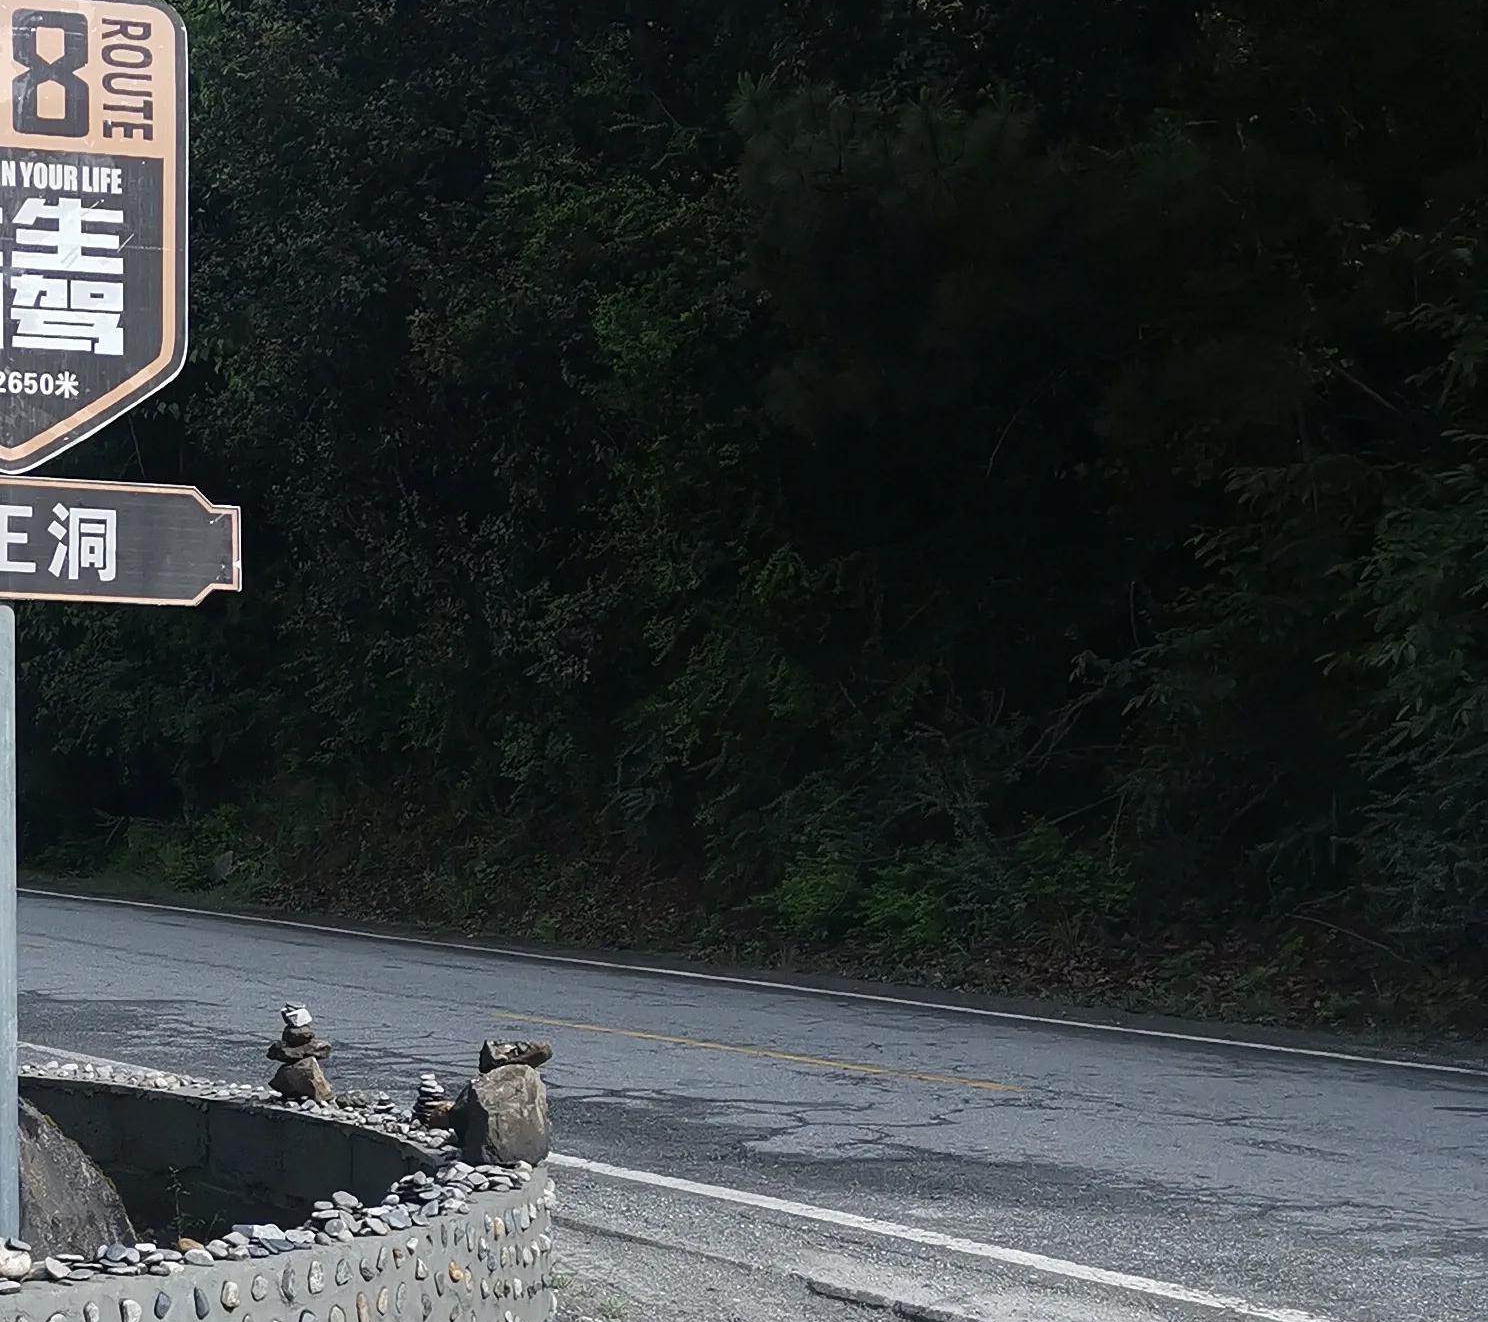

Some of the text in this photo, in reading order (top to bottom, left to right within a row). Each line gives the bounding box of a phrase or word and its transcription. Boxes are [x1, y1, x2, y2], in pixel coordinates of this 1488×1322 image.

[100, 15, 154, 143] ROUTE
[20, 161, 79, 191] YOUR
[81, 165, 123, 195] LIFE
